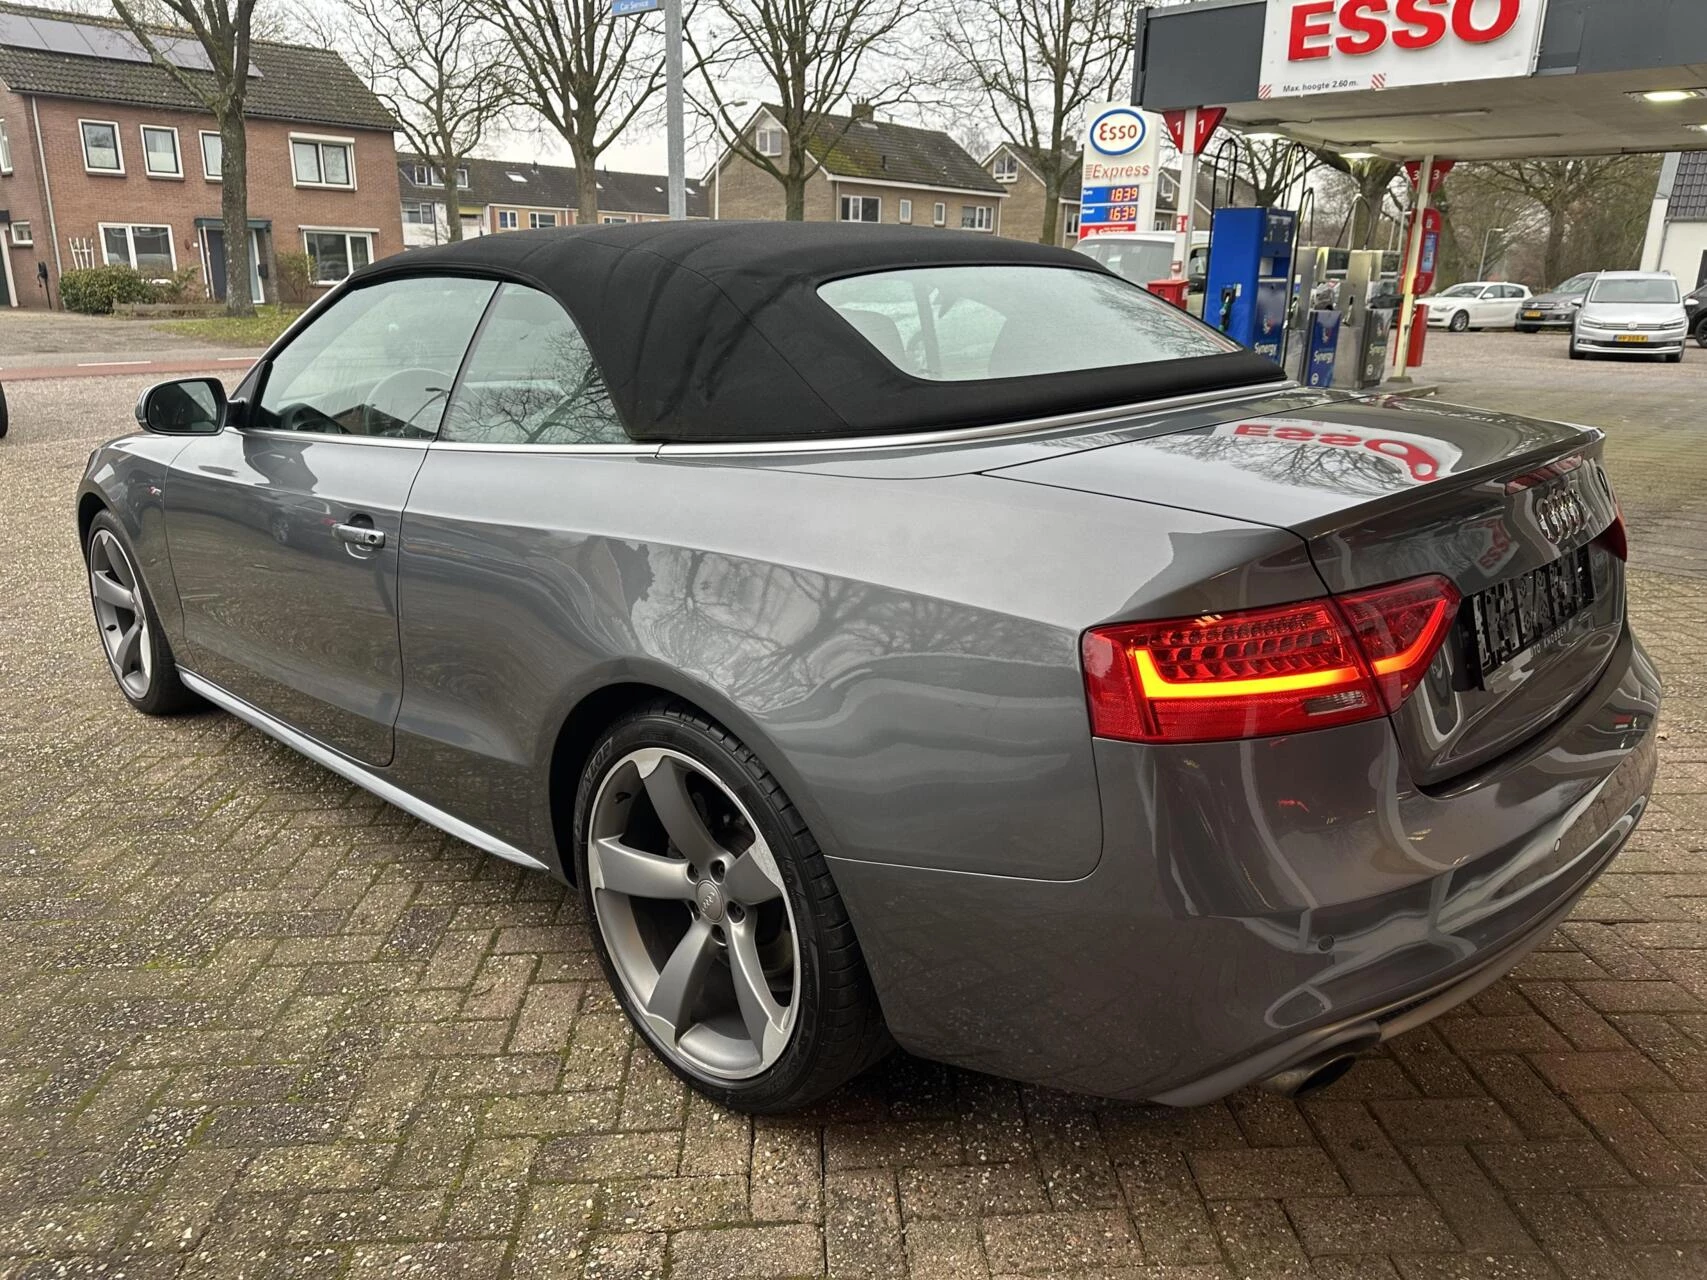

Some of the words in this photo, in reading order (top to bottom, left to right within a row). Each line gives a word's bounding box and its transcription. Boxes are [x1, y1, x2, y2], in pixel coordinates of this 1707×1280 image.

[1288, 0, 1521, 61] ESSO
[1302, 82, 1330, 91] hoogte
[1175, 120, 1182, 135] 1
[1198, 119, 1205, 134] 1
[1092, 164, 1150, 181] Express
[1254, 342, 1278, 355] Synergy
[1313, 350, 1334, 364] Synergy
